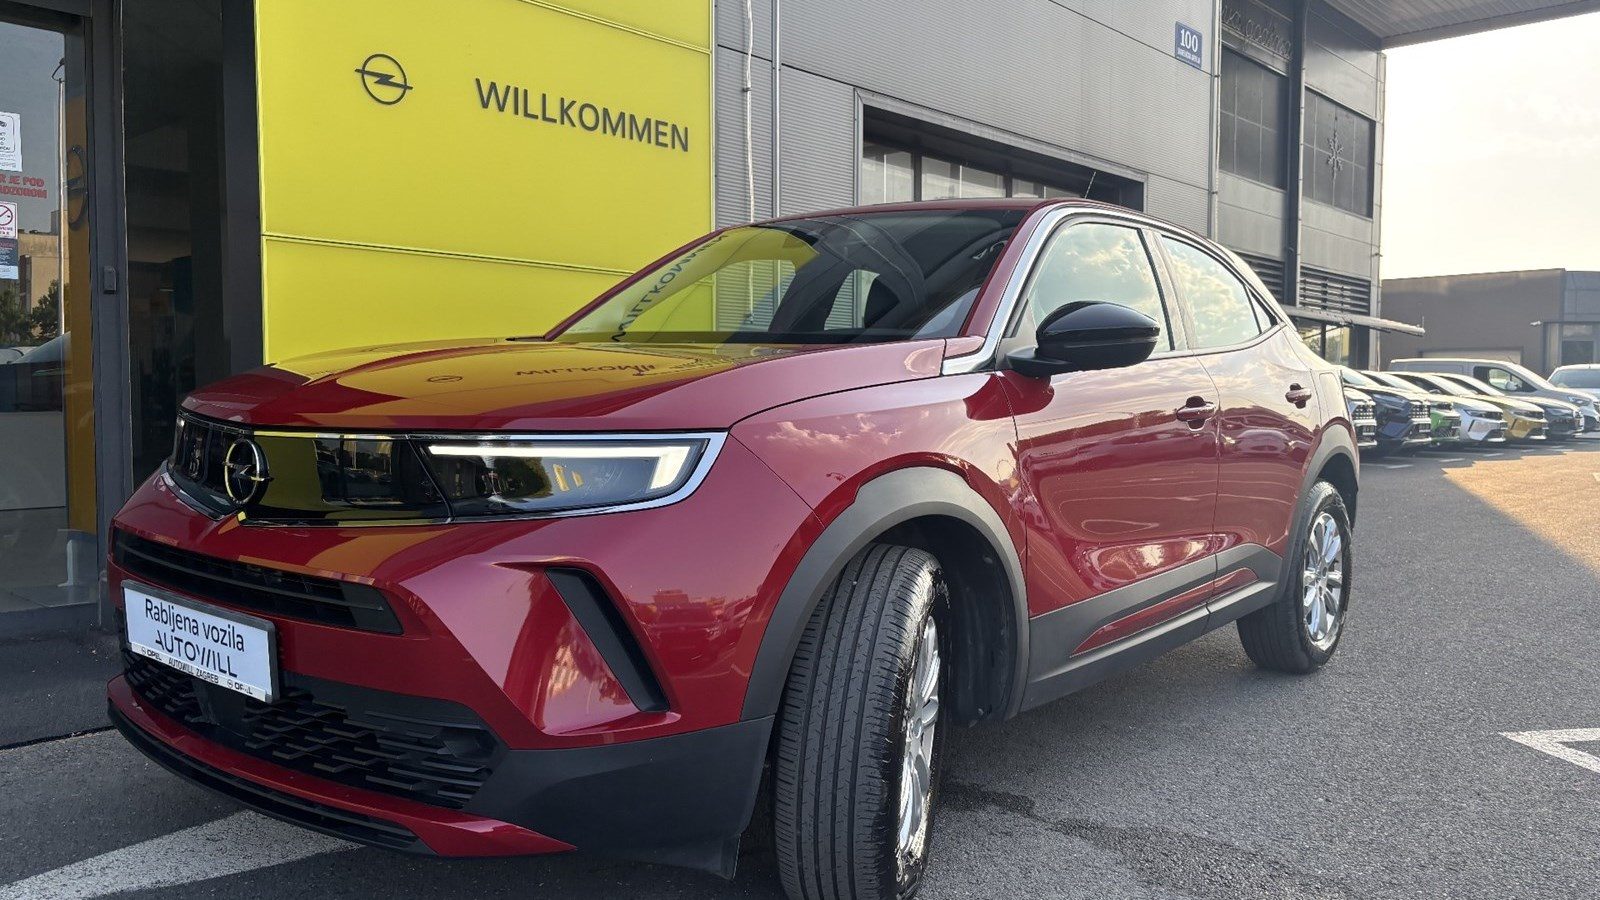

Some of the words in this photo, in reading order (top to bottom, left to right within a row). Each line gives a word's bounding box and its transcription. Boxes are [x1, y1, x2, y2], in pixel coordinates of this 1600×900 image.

[1180, 29, 1198, 52] 100
[475, 77, 690, 152] WILLKOMMEN
[23, 176, 45, 187] POD
[145, 598, 199, 636] Rabljena
[202, 622, 245, 652] vozila
[168, 657, 195, 676] AUTOWILL
[196, 668, 219, 684] ZAGREB
